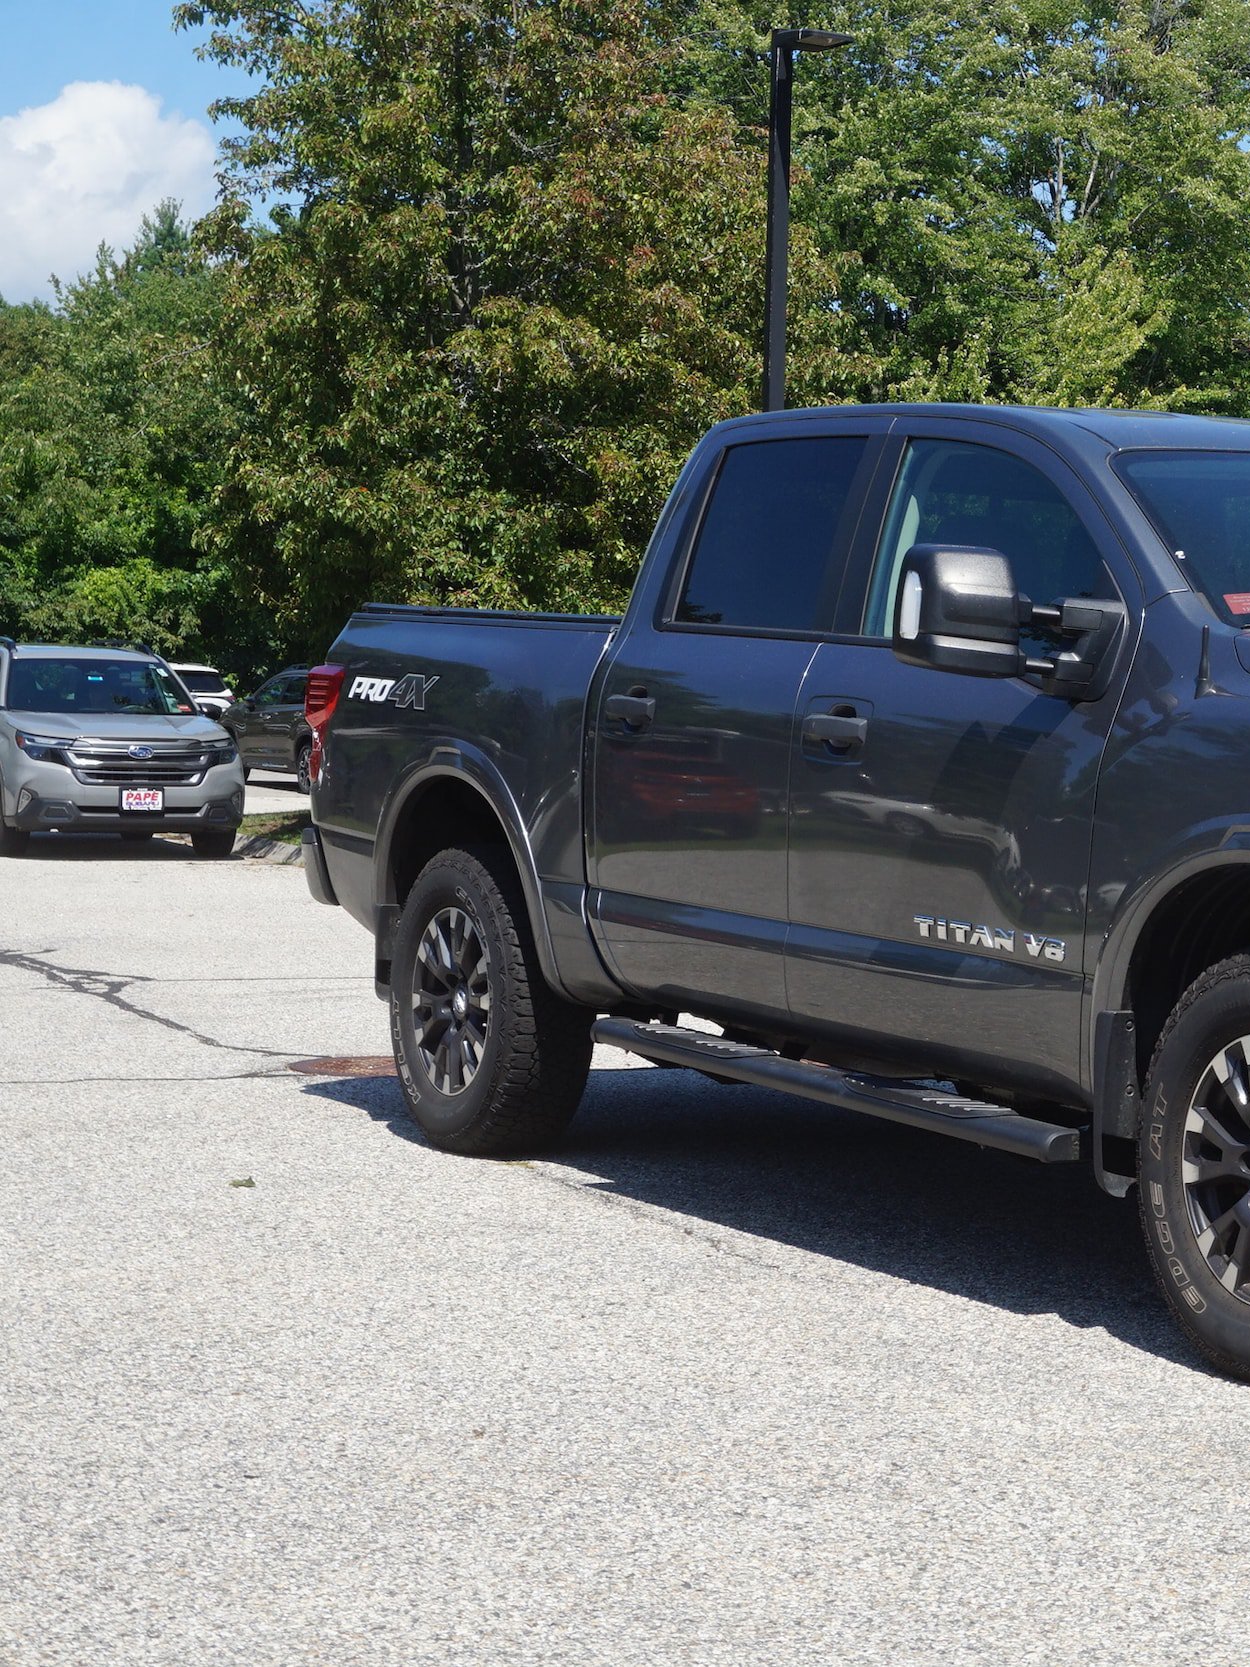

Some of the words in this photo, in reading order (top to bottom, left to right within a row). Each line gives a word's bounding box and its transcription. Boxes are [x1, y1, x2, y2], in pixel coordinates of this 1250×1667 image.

[126, 792, 159, 801] PAPE
[913, 914, 1015, 953] TITAN
[1023, 932, 1066, 962] V8
[1150, 1181, 1207, 1314] EDGE
